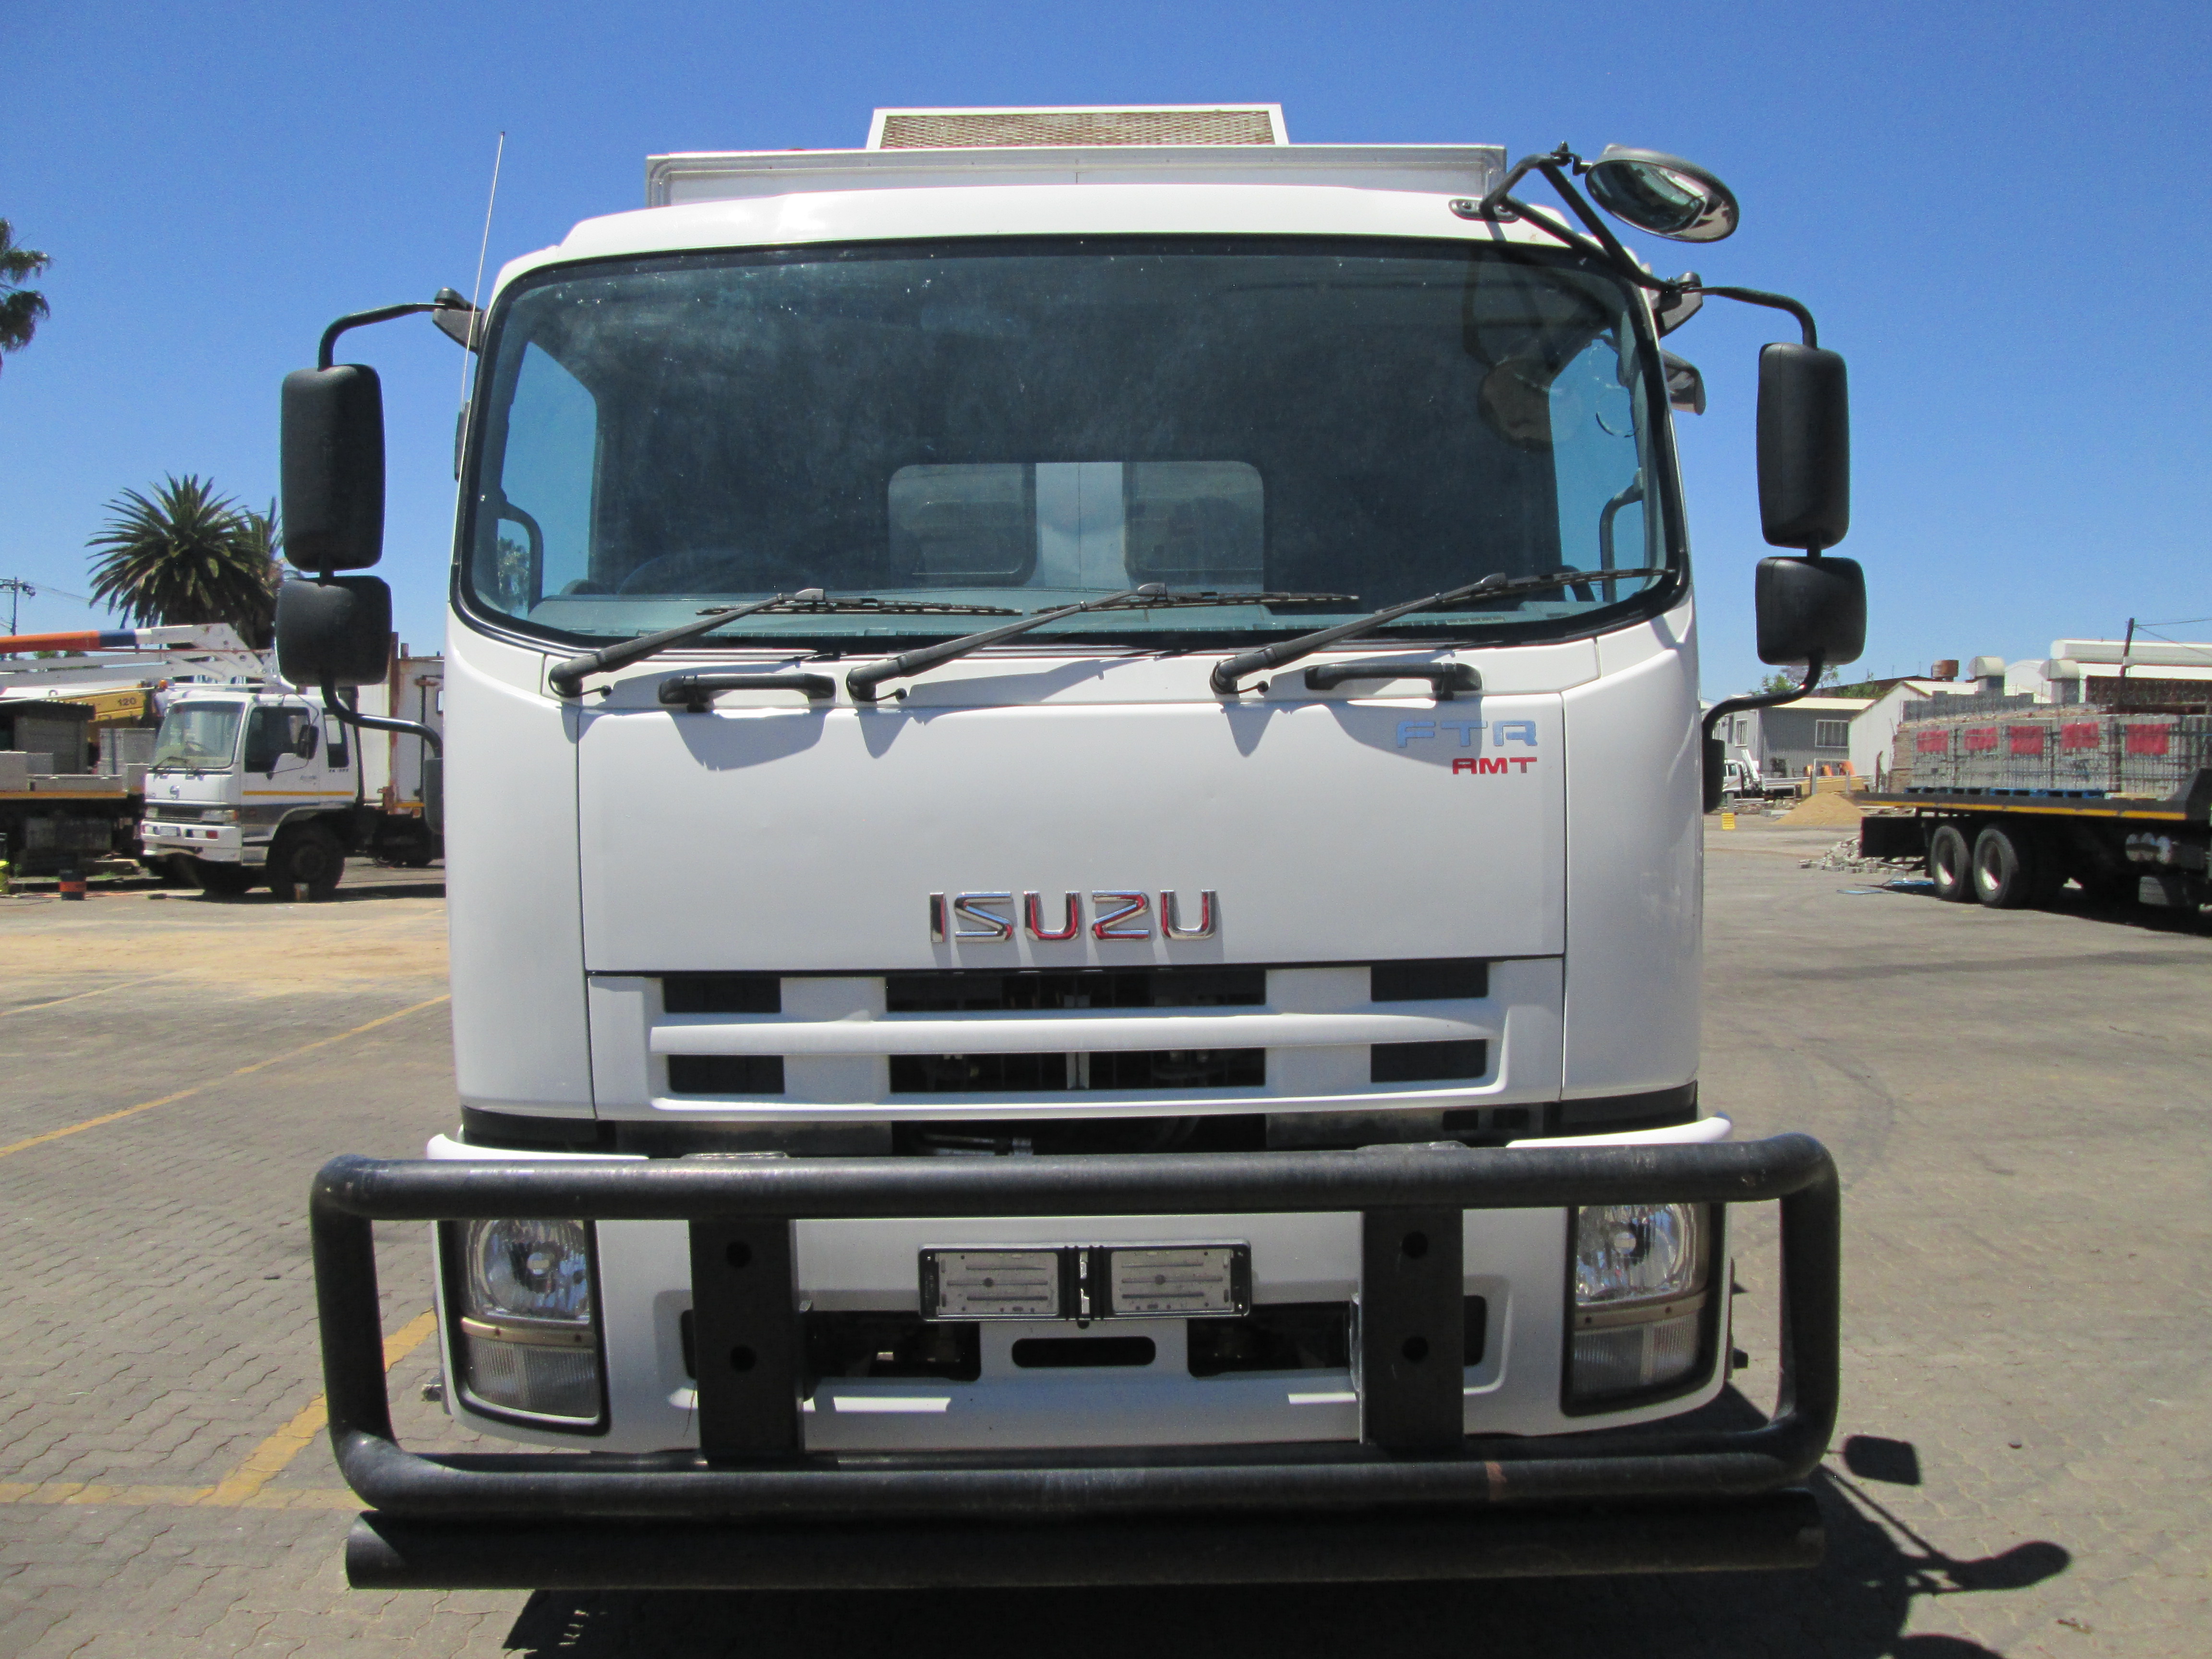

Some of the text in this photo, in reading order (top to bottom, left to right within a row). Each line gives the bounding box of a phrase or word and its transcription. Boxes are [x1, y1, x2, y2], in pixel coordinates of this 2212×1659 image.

[118, 697, 137, 706] 120
[1397, 720, 1538, 748] FTR
[1452, 757, 1538, 775] AMT
[929, 890, 1216, 943] ISUZU
